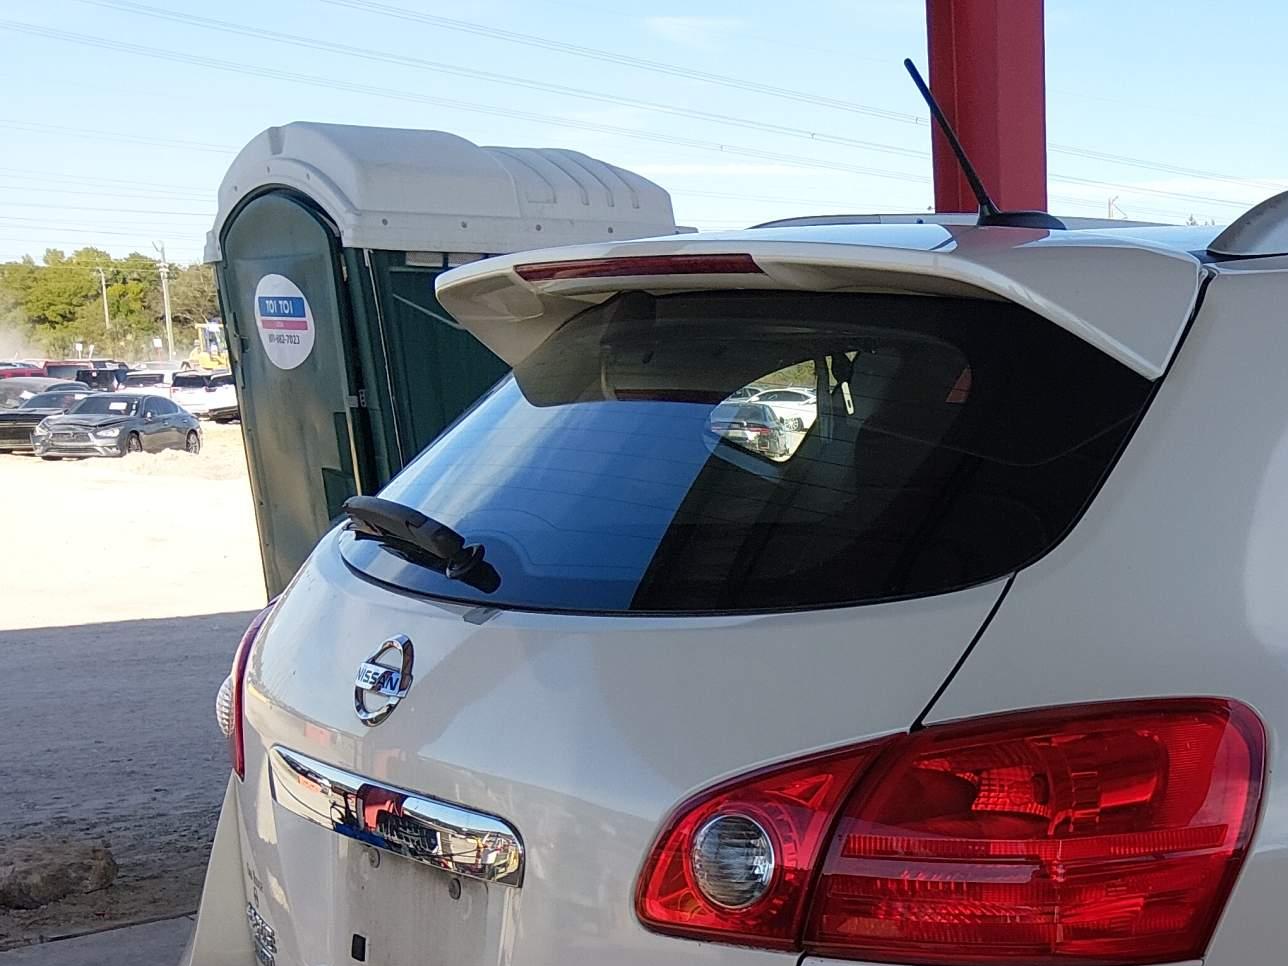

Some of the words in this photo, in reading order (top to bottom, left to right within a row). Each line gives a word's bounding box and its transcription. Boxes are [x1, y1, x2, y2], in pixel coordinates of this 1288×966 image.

[265, 299, 277, 313] TOI
[278, 299, 294, 314] TOI
[357, 666, 400, 691] NISSAN
